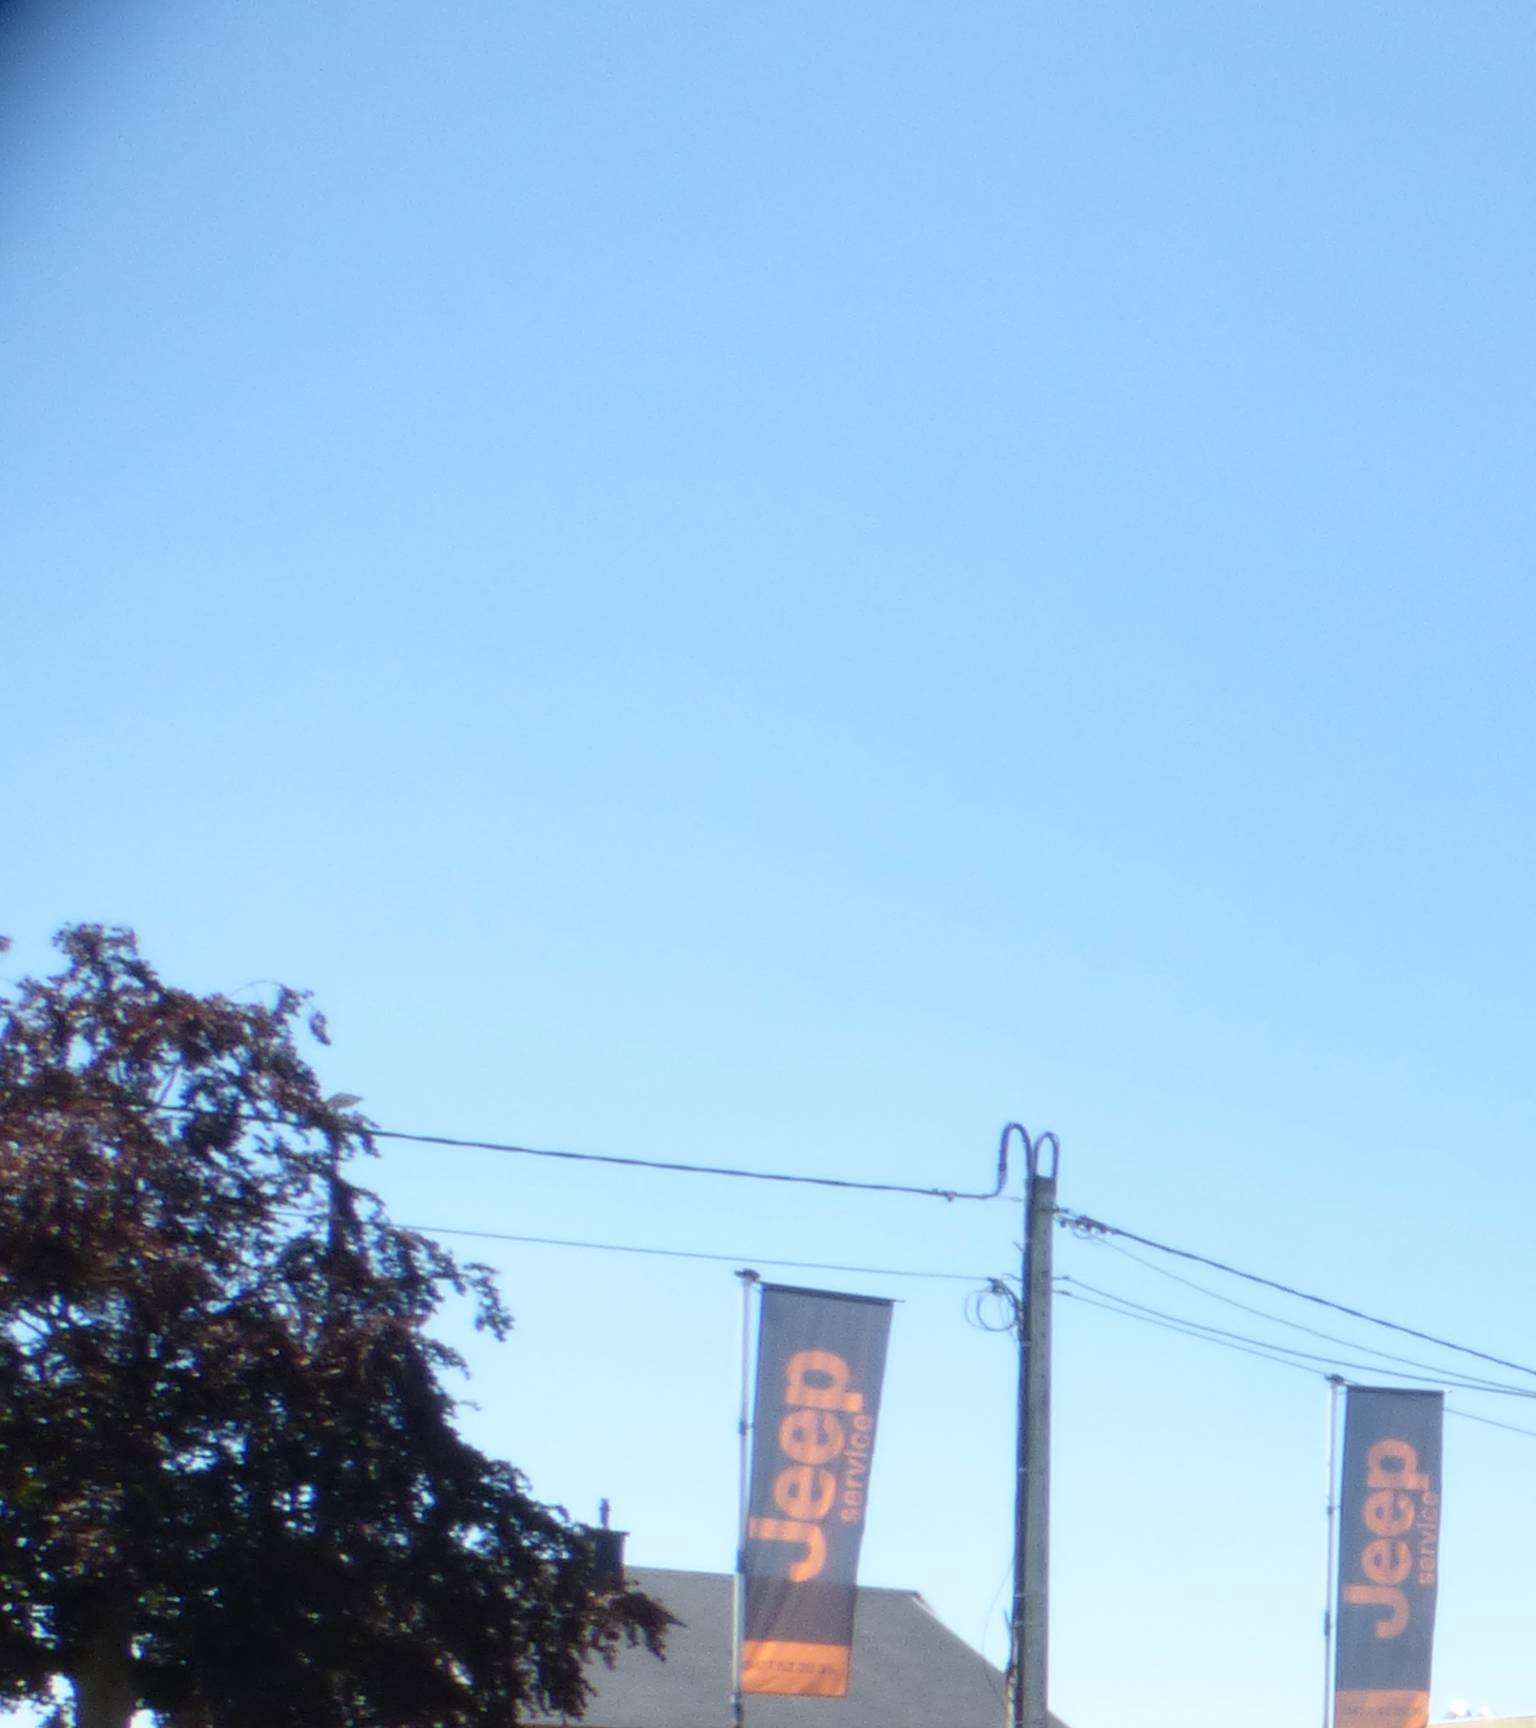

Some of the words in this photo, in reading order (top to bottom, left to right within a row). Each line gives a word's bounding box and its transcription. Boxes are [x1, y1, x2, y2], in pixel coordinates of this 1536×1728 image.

[748, 1350, 863, 1582] Jeep
[840, 1415, 872, 1523] service
[1342, 1438, 1429, 1639] Jeep
